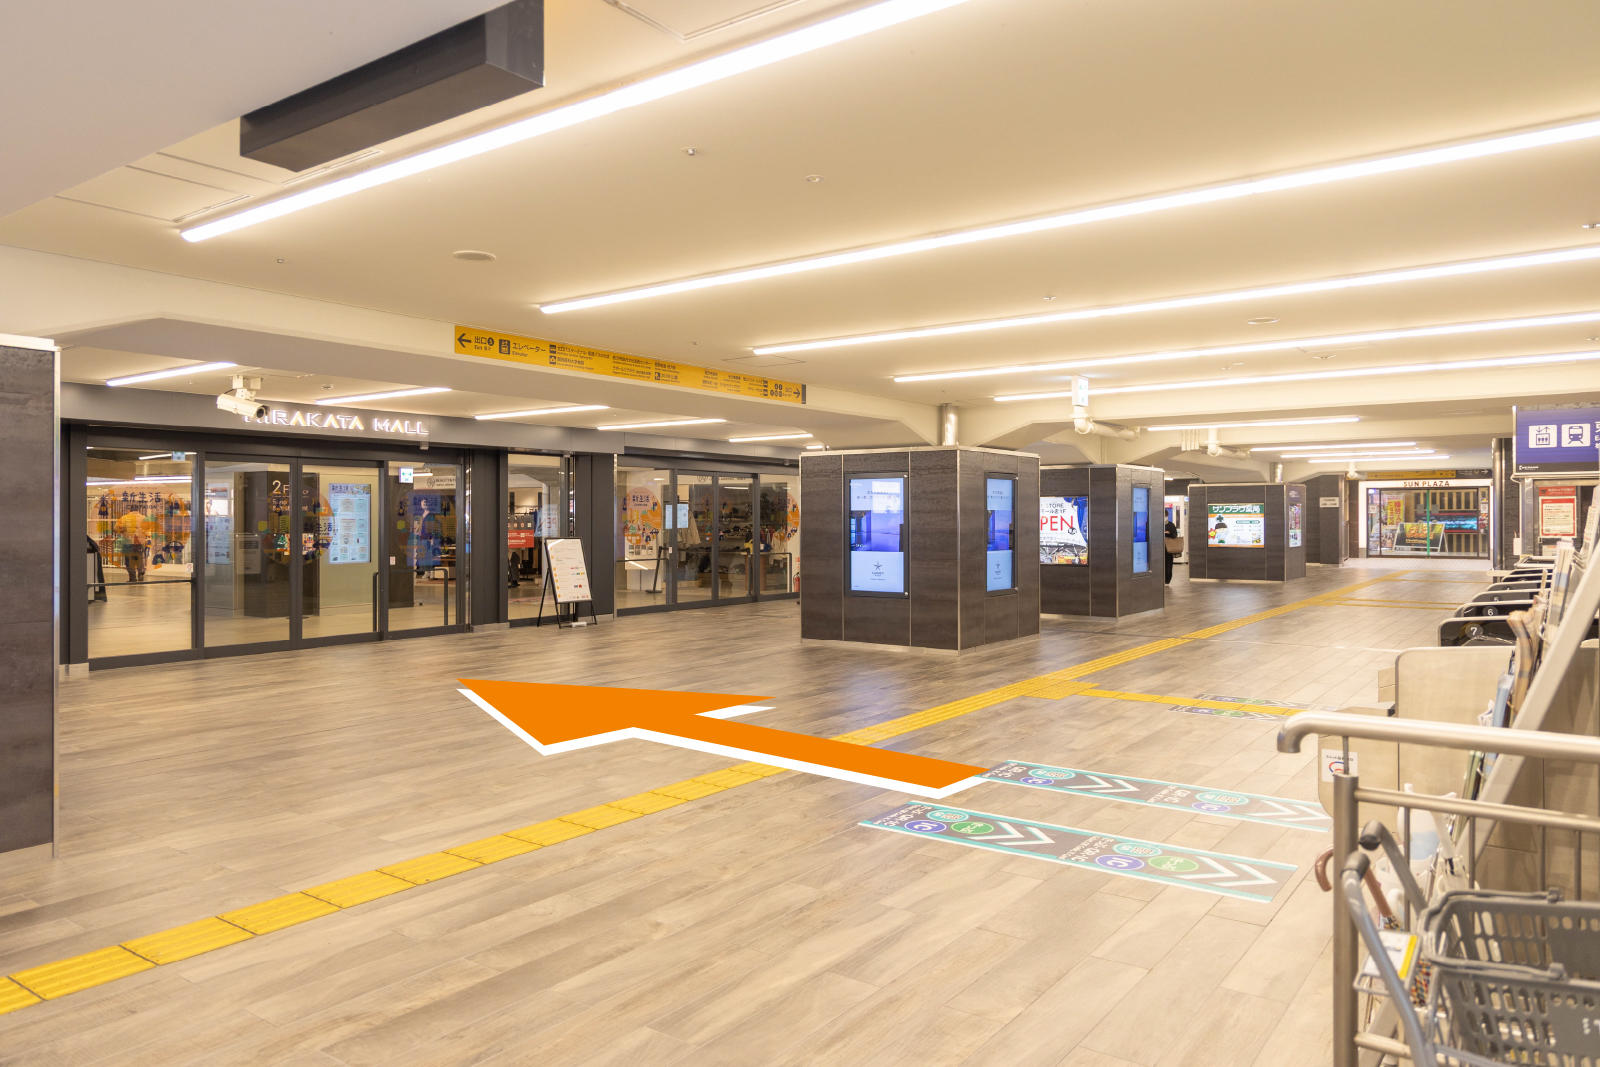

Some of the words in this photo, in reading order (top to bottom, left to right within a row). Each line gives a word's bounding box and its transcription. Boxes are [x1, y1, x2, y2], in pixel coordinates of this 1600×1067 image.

[512, 342, 547, 353] エレベーター
[373, 417, 430, 435] MALL
[1403, 480, 1420, 488] SUN
[1422, 480, 1450, 488] PLAZA
[122, 491, 161, 503] 新生活
[1487, 608, 1494, 616] 6
[1470, 626, 1478, 636] 7
[913, 822, 939, 831] IC
[1106, 857, 1133, 868] IC
